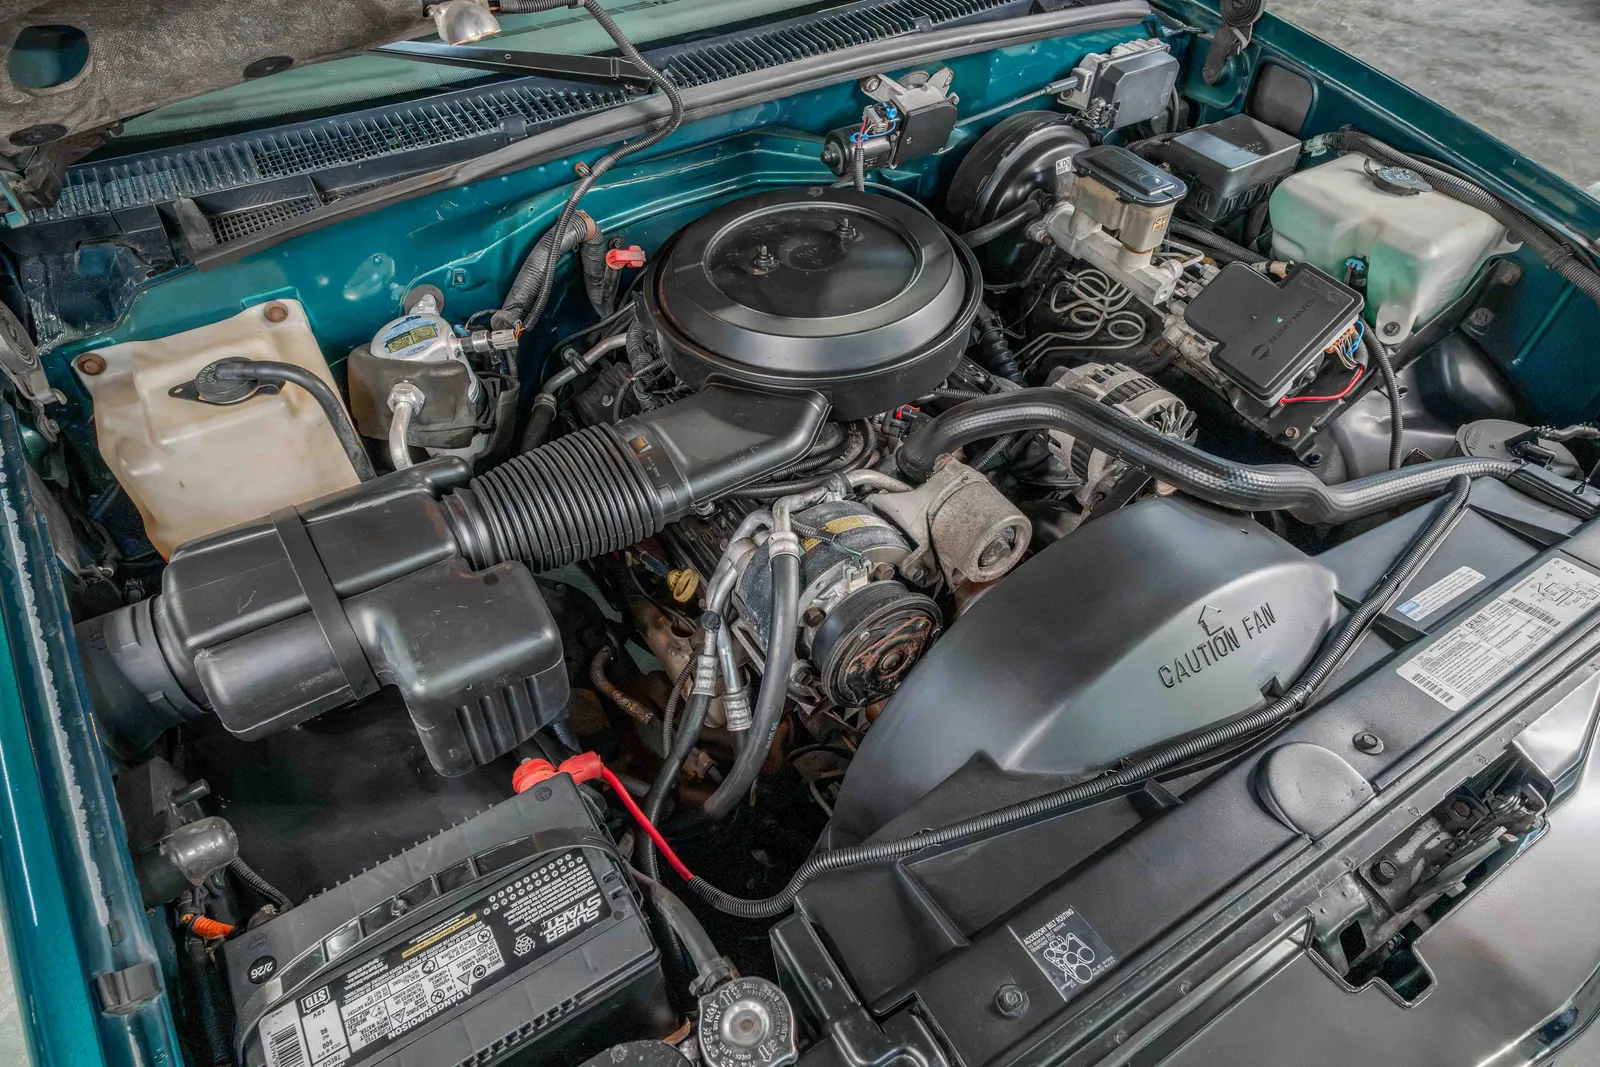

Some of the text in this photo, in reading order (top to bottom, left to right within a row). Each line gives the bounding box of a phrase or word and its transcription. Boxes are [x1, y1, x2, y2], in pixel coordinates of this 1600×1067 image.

[1158, 602, 1276, 688] CAUTION FAN
[543, 893, 601, 934] START
[546, 909, 599, 943] SUPER
[1023, 908, 1074, 945] ACCESSORY BELT ROUTING
[461, 947, 497, 971] EXPLOSIVE GASES
[486, 957, 501, 969] SHIELD
[250, 961, 273, 979] 2/26
[305, 990, 327, 1009] STD
[363, 997, 374, 1007] OPEN
[404, 1001, 426, 1016] SULFURIC
[413, 996, 424, 1005] ACID
[312, 1008, 326, 1019] 12V
[344, 1009, 370, 1027] HELP FAST.
[386, 990, 463, 1039] DANGER/POISON
[346, 1016, 367, 1031] MEDICAL
[347, 1027, 357, 1036] GET
[357, 1015, 388, 1036] WITH WATER.
[358, 1020, 390, 1041] IMMEDIATELY
[703, 1000, 720, 1057] OPEN HOT
[364, 1025, 391, 1043] FLUSH EYES
